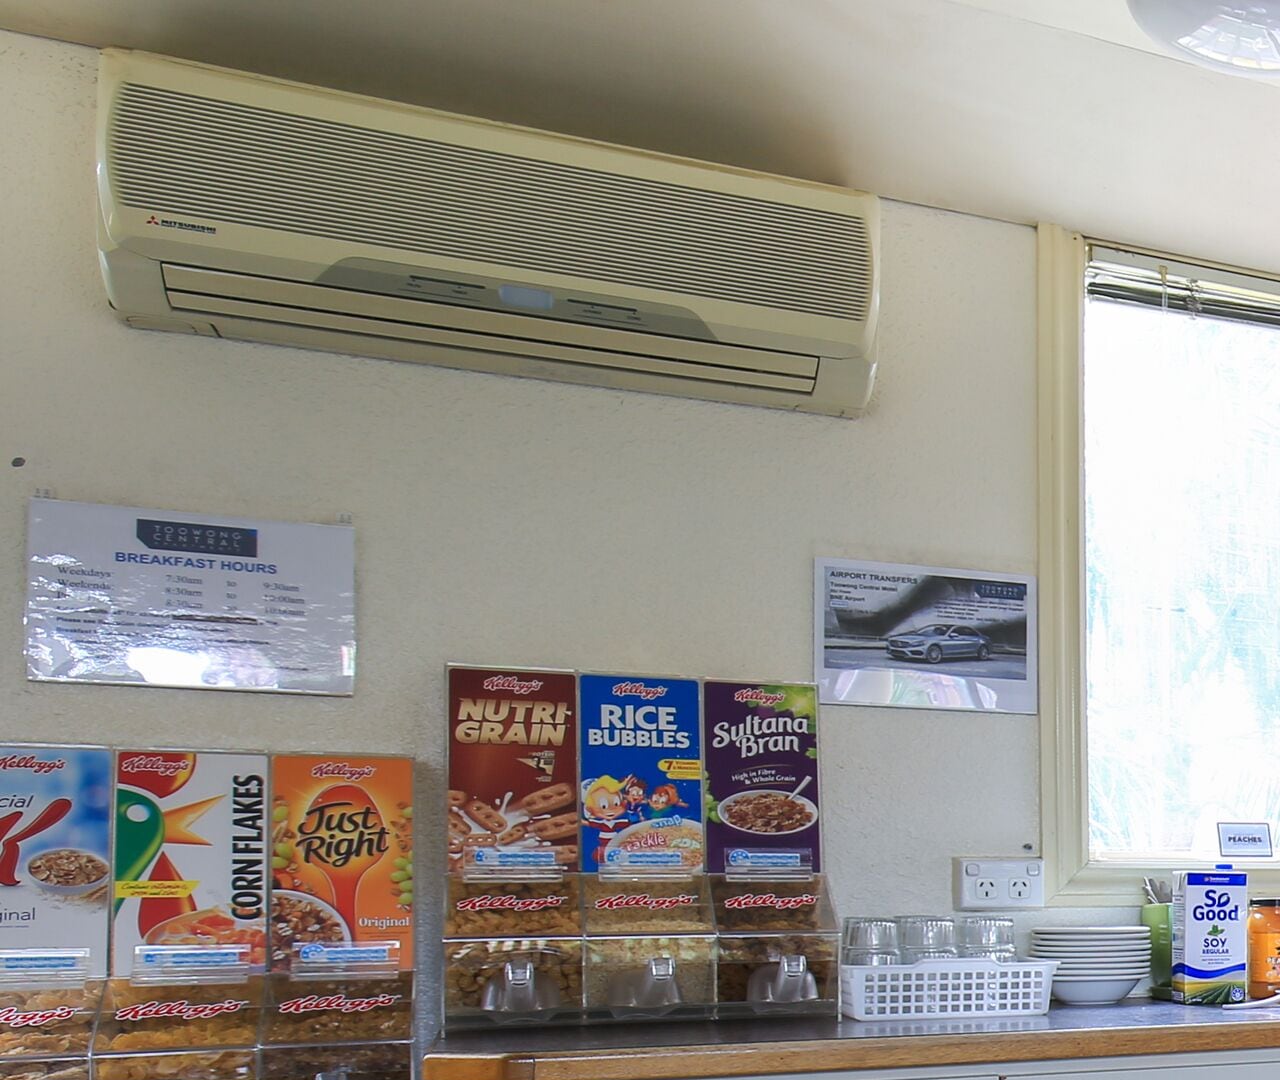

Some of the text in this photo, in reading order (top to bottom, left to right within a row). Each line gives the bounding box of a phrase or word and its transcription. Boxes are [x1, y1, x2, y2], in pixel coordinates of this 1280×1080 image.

[115, 551, 278, 575] BREAKFAST HOURS
[166, 574, 202, 585] 7:30am
[830, 571, 917, 584] AIRPORT TRANSFERS
[483, 676, 541, 693] Kellogg's
[613, 682, 667, 699] Kellogg's
[735, 689, 785, 703] Kellogg's
[600, 705, 677, 730] RICE
[455, 722, 567, 746] GRAIN
[588, 728, 690, 748] BUBBLES
[713, 714, 808, 748] Sultana
[741, 734, 798, 758] Bran
[122, 756, 190, 775] Kellogg's
[311, 762, 375, 779] Kellogg's
[732, 773, 747, 782] High
[753, 776, 775, 784] Whole
[297, 802, 377, 836] Just
[232, 774, 264, 920] CORN FLAKES
[296, 827, 390, 867] Right
[1228, 835, 1262, 844] PEACHES
[1192, 905, 1239, 921] Good
[359, 916, 410, 929] Original
[1203, 938, 1227, 949] SOY
